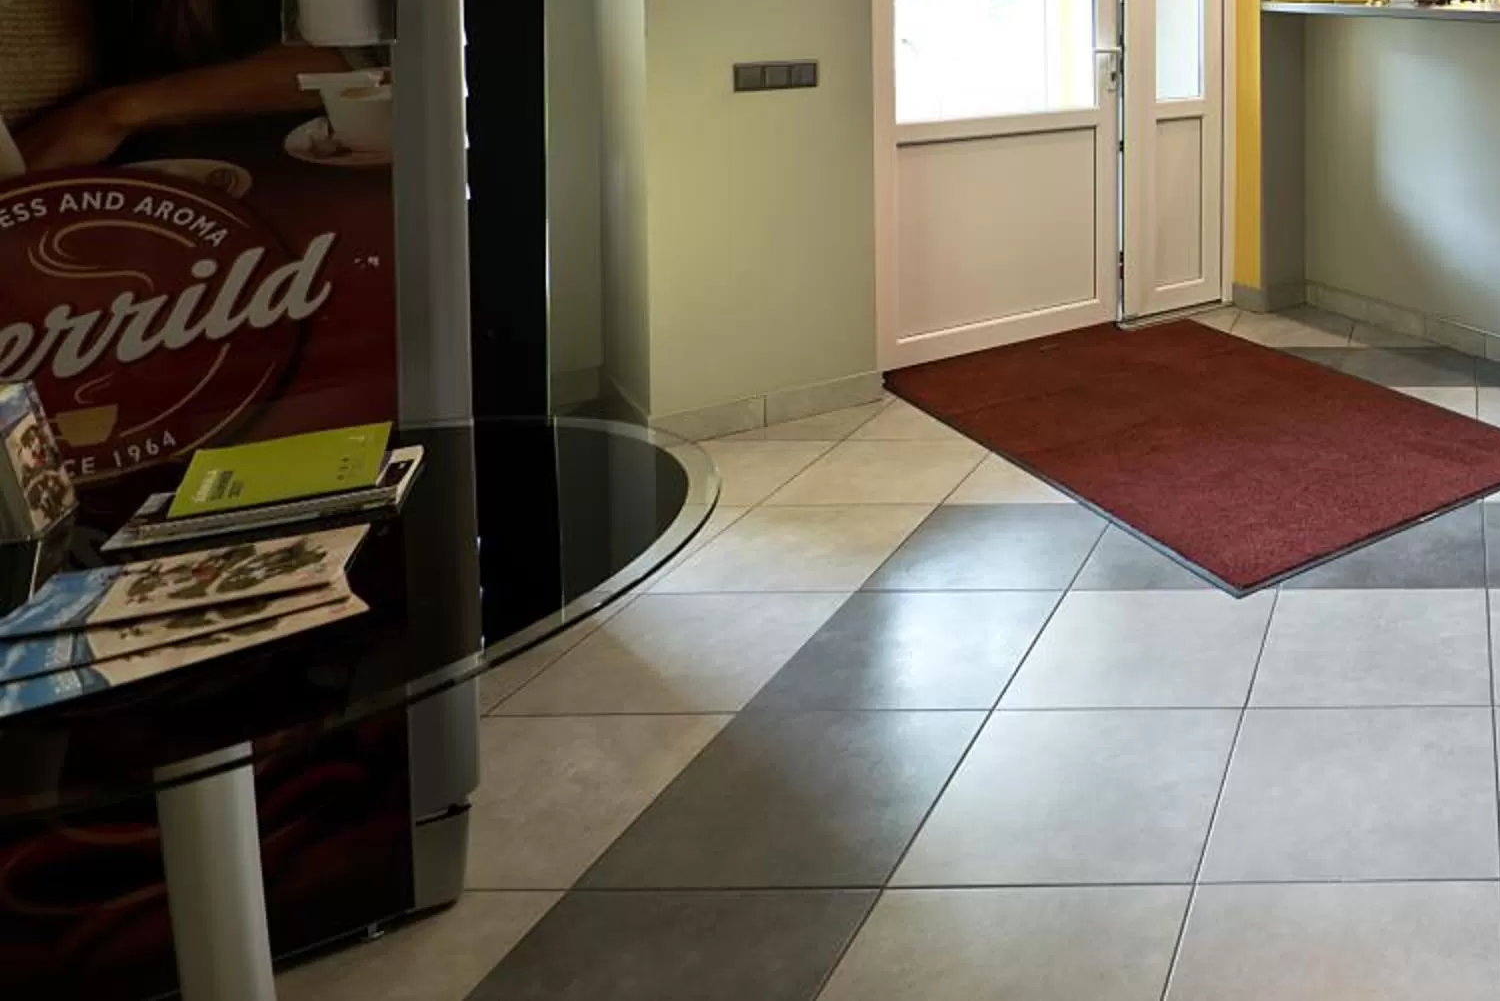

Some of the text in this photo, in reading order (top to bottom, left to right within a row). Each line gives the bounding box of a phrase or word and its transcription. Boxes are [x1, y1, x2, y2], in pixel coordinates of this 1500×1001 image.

[59, 191, 125, 213] AND
[133, 196, 229, 248] AROMA
[113, 430, 176, 467] 1964
